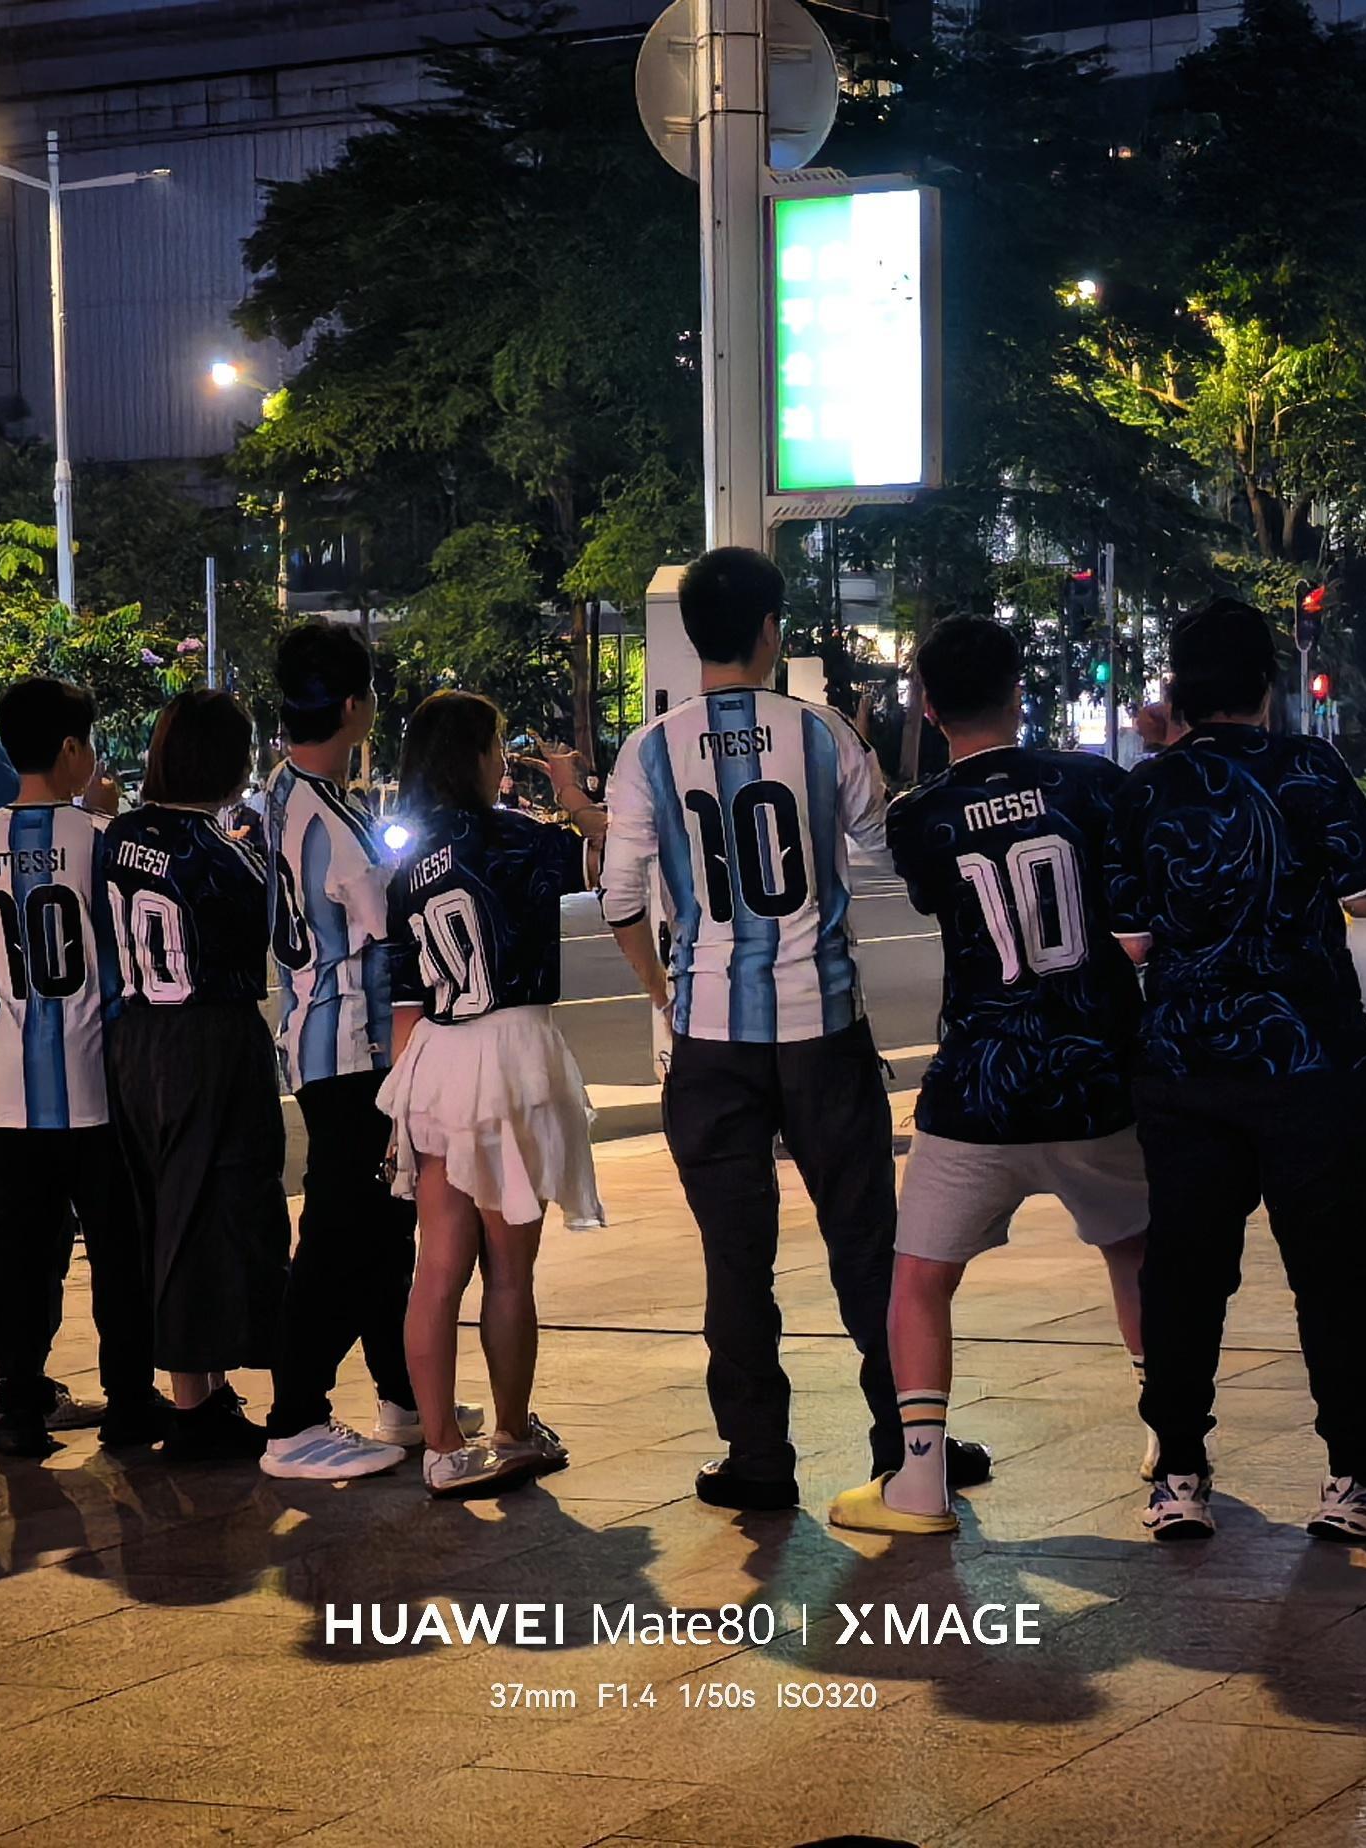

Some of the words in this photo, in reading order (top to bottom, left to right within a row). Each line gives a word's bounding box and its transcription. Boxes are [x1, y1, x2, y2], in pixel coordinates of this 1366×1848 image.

[699, 725, 772, 760] MESSI
[684, 779, 808, 923] 10
[964, 788, 1046, 832] MESSI
[117, 840, 171, 878] MESSI
[410, 845, 452, 894] MESSI
[107, 880, 193, 1005] 10
[956, 834, 1088, 985] 10
[407, 888, 495, 1021] 10
